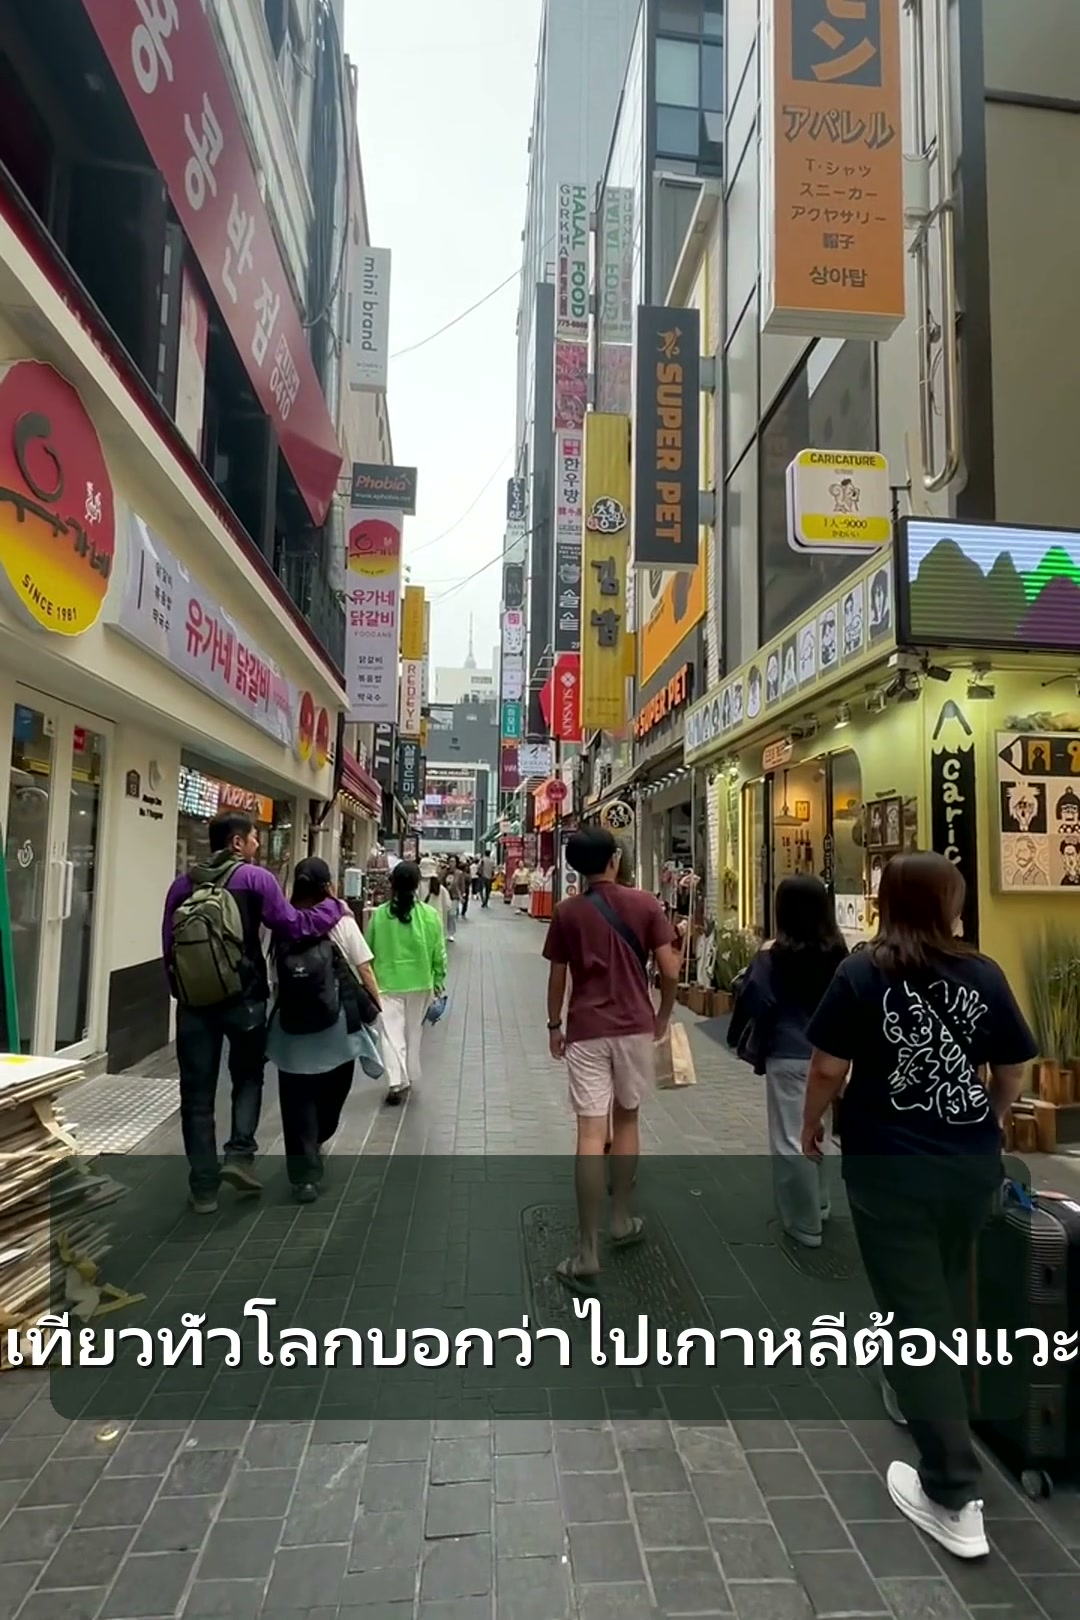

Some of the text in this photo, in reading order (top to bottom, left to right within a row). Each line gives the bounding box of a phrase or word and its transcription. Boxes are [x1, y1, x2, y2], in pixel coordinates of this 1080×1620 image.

[782, 104, 896, 149] アパレル
[800, 182, 878, 201] スニーカー
[559, 184, 570, 257] GURKHA
[363, 256, 378, 295] mini
[571, 186, 586, 318] HALAL FOOD
[809, 265, 869, 289] 상아탑
[362, 301, 378, 352] brand
[270, 367, 290, 421] 0410
[655, 363, 682, 544] SUPER PET
[810, 453, 876, 466] CARICATURE
[356, 474, 407, 491] Phobia
[563, 458, 580, 504] 한우방
[22, 574, 78, 622] SINCE 1981
[351, 610, 394, 627] 닭갈비
[352, 590, 395, 606] 유가네
[185, 598, 271, 713] 유가네 닭갈비
[406, 664, 416, 730] REDEYE
[668, 663, 688, 711] PET
